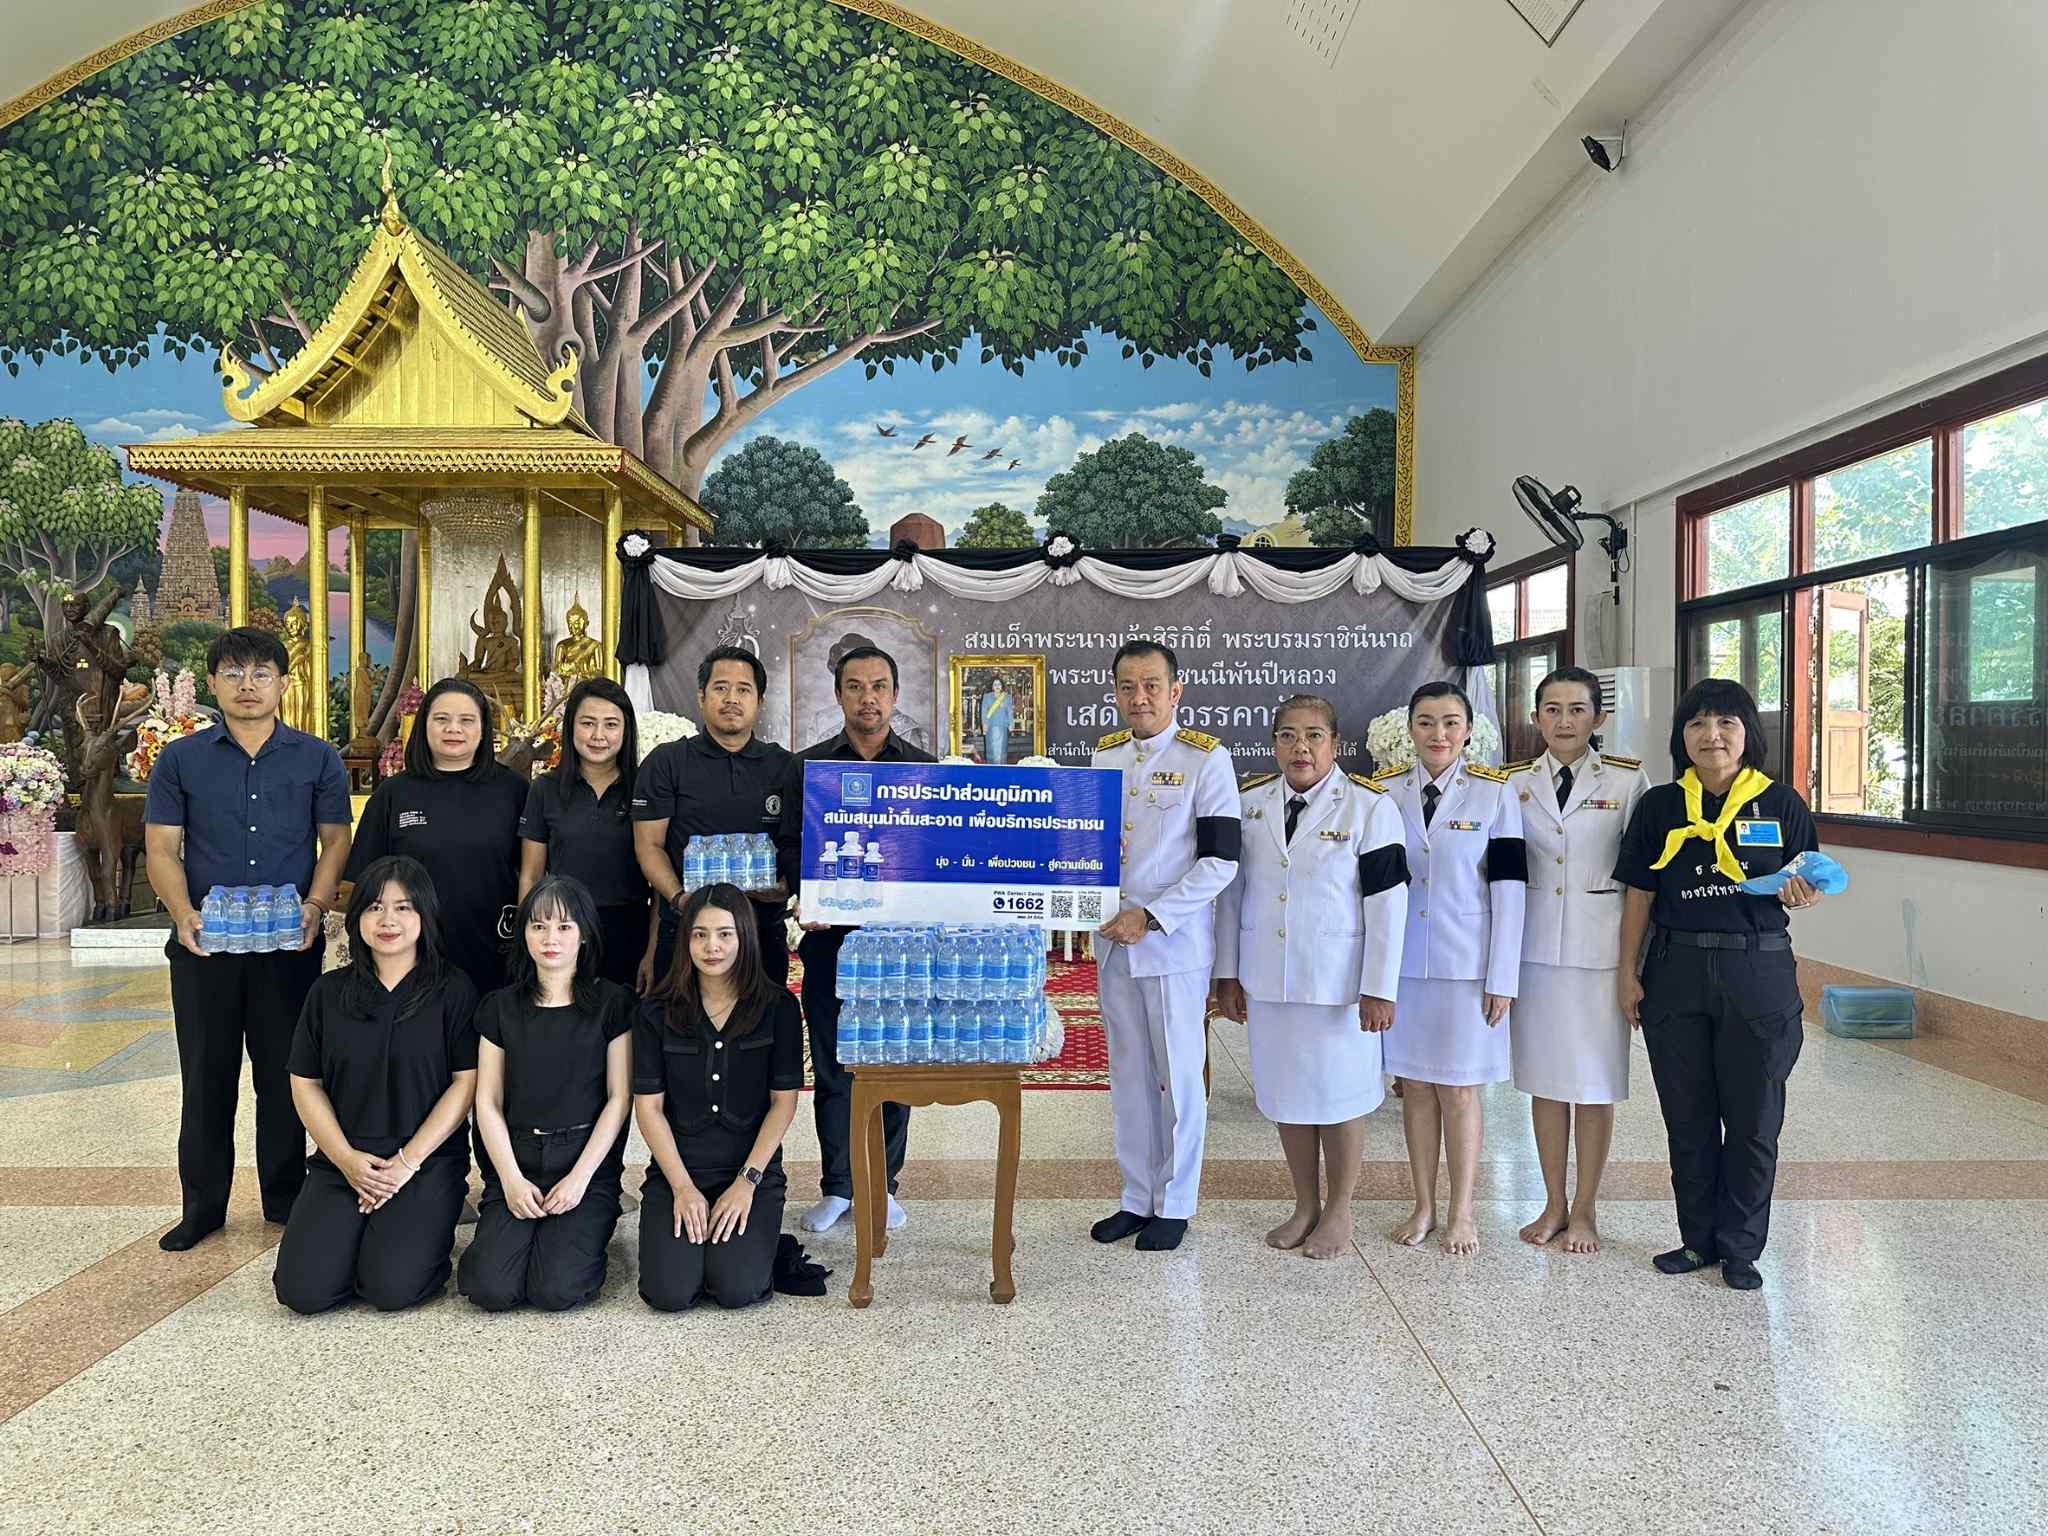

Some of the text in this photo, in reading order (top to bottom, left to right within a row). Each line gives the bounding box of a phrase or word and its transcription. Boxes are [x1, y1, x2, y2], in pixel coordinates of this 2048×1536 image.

[1222, 623, 1414, 649] พระบรมราชินีนาถ
[876, 783, 1053, 806] การประปาส่วนภูมิภาค
[823, 806, 1105, 831] สนับสนุนน้ำดื่มสะอาด เพื่อบริการประชาชน
[1007, 897, 1044, 911] 1662
